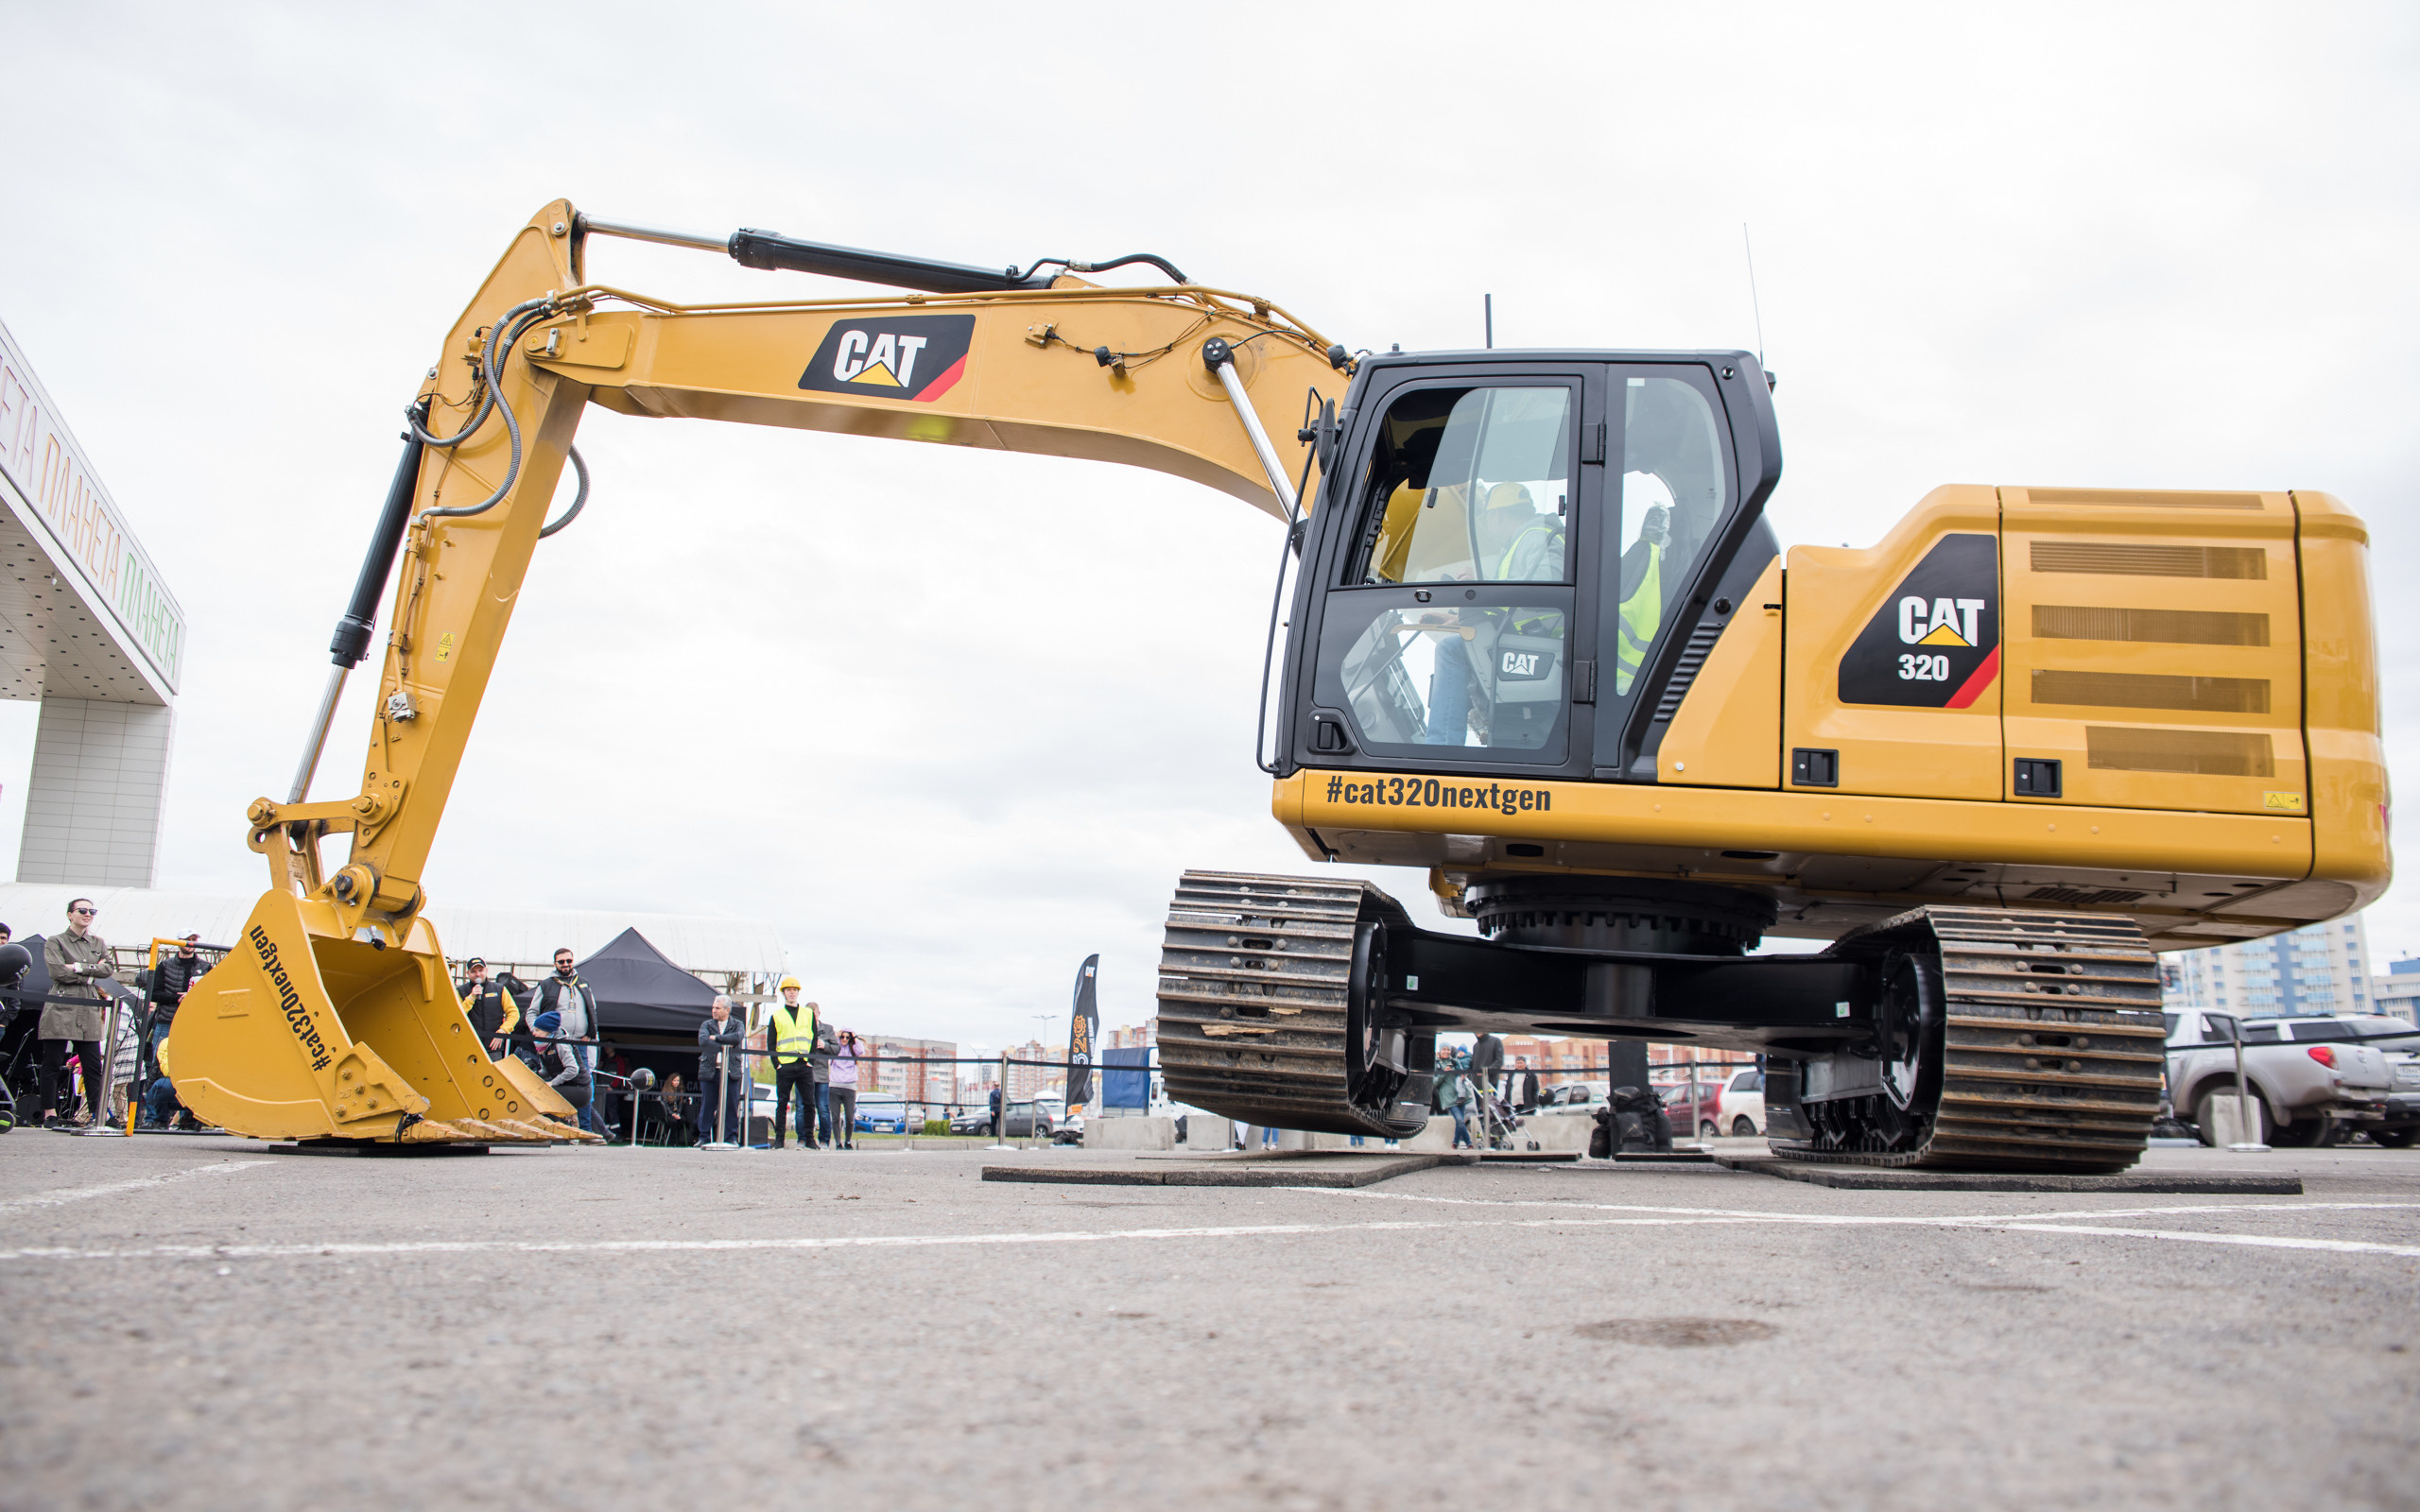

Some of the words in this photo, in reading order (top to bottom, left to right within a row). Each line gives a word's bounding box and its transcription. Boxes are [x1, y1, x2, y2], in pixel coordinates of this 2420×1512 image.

[833, 330, 927, 388] CAT
[0, 353, 38, 488] ЕТА
[39, 433, 120, 601] ПЛАНЕТА
[120, 552, 179, 679] ПЛАНЕТА
[1898, 595, 1985, 647] CAT
[1502, 652, 1539, 676] CAT
[1898, 653, 1949, 681] 320
[1327, 776, 1551, 816] #cat320nextgen
[250, 924, 332, 1072] #cat320nextgen
